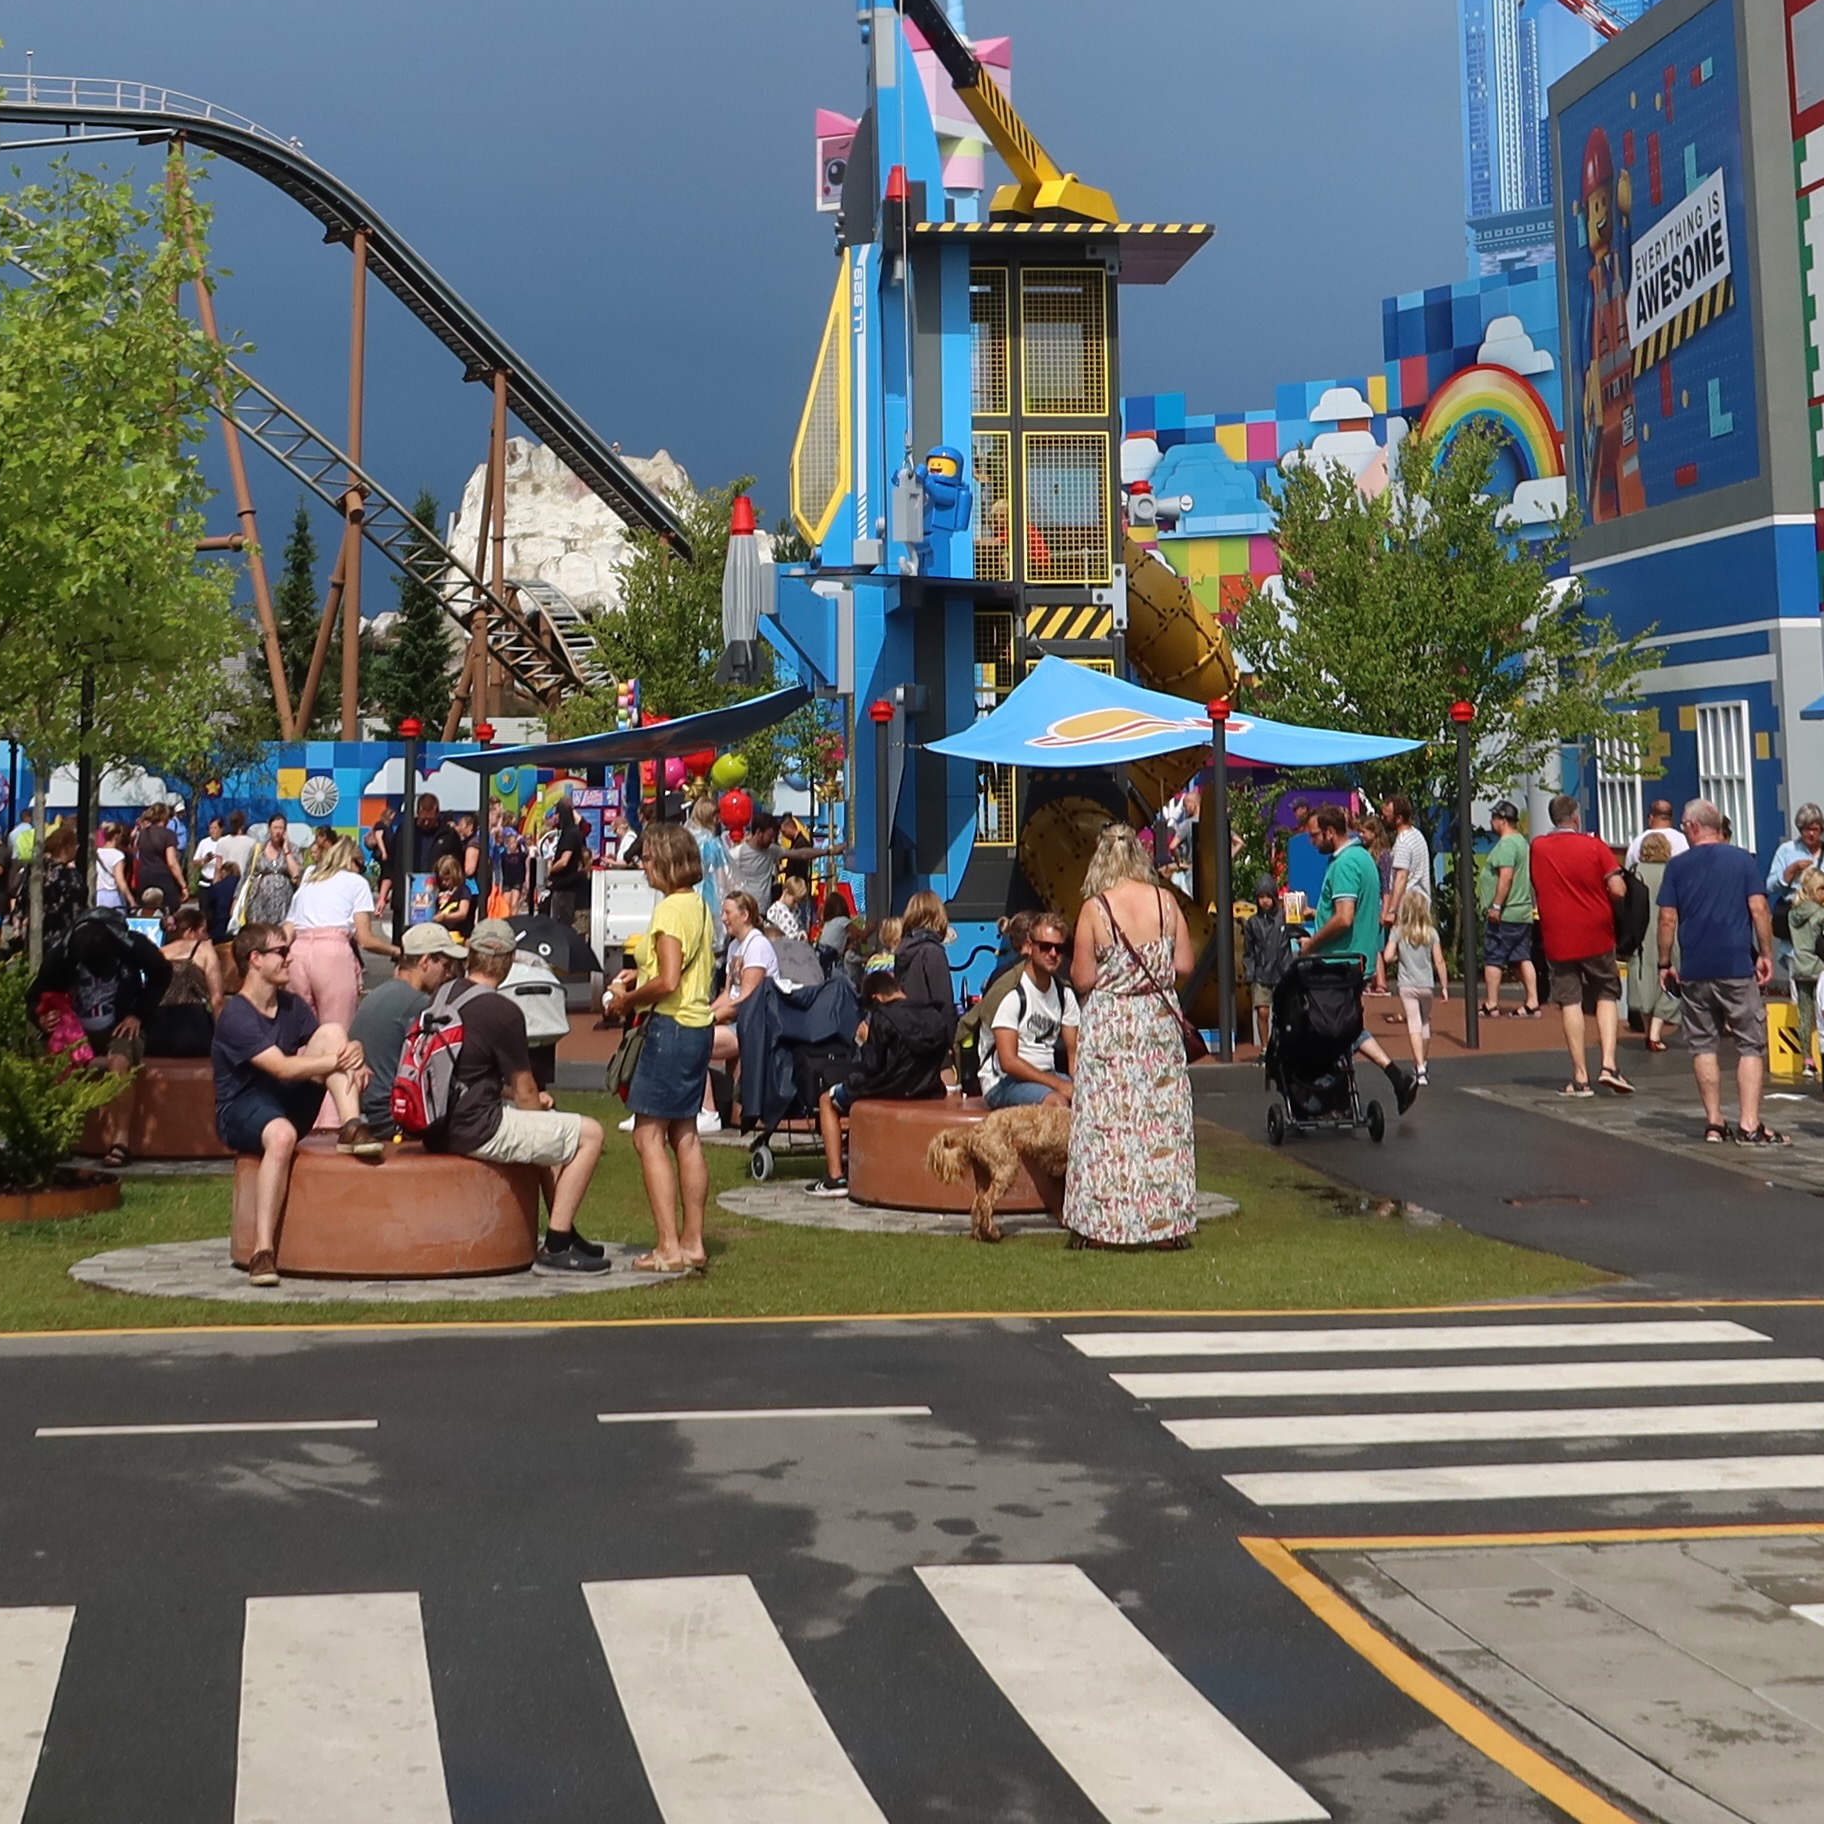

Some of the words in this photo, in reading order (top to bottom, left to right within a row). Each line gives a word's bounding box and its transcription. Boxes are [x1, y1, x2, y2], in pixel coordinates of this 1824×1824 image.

[1634, 205, 1704, 282] EVERYTHING
[1707, 190, 1721, 220] IS
[1635, 218, 1725, 331] AWESOME
